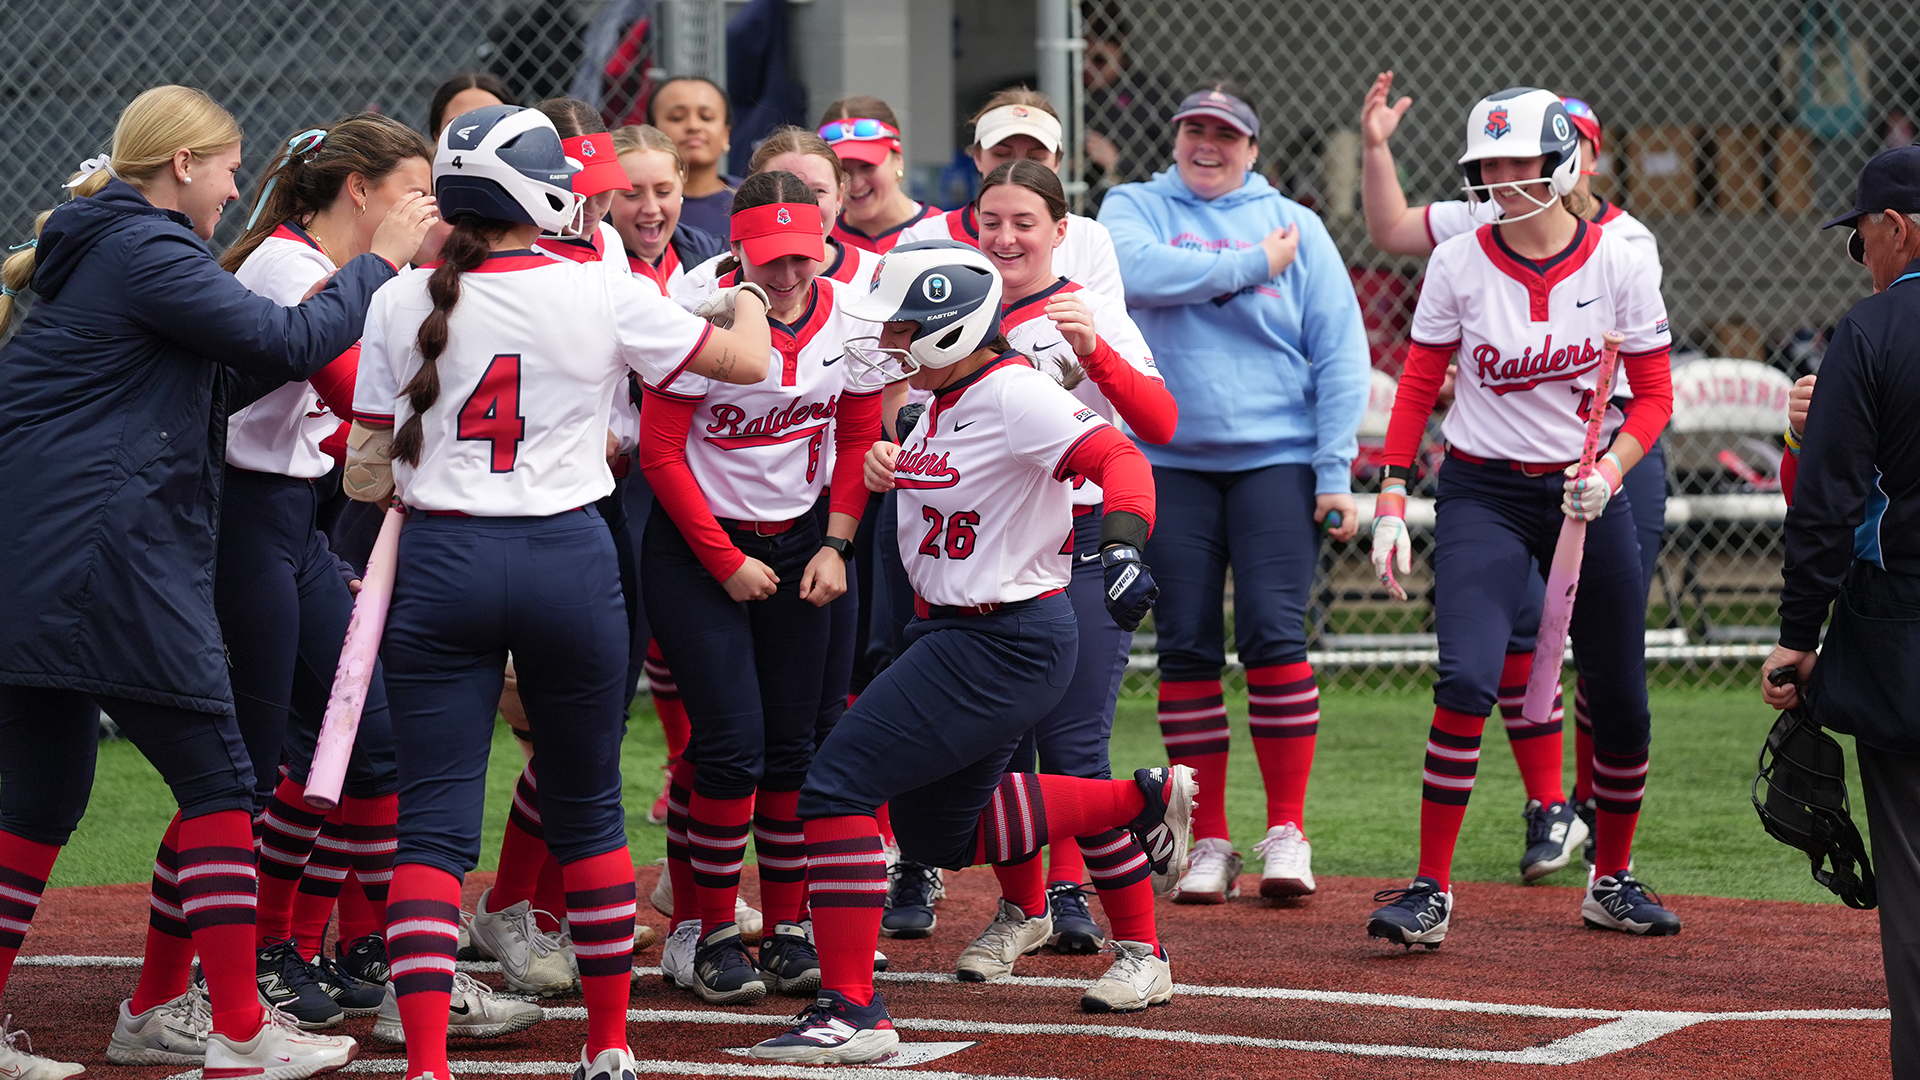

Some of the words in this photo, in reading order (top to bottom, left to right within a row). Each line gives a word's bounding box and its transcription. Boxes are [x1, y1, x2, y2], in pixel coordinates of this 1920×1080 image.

[452, 156, 463, 169] 4
[926, 310, 958, 321] EASTON
[1473, 334, 1602, 380] Raiders
[456, 353, 525, 474] 4
[706, 394, 837, 437] Raiders
[806, 430, 823, 485] 6
[894, 437, 950, 477] aiders
[918, 504, 980, 561] 26
